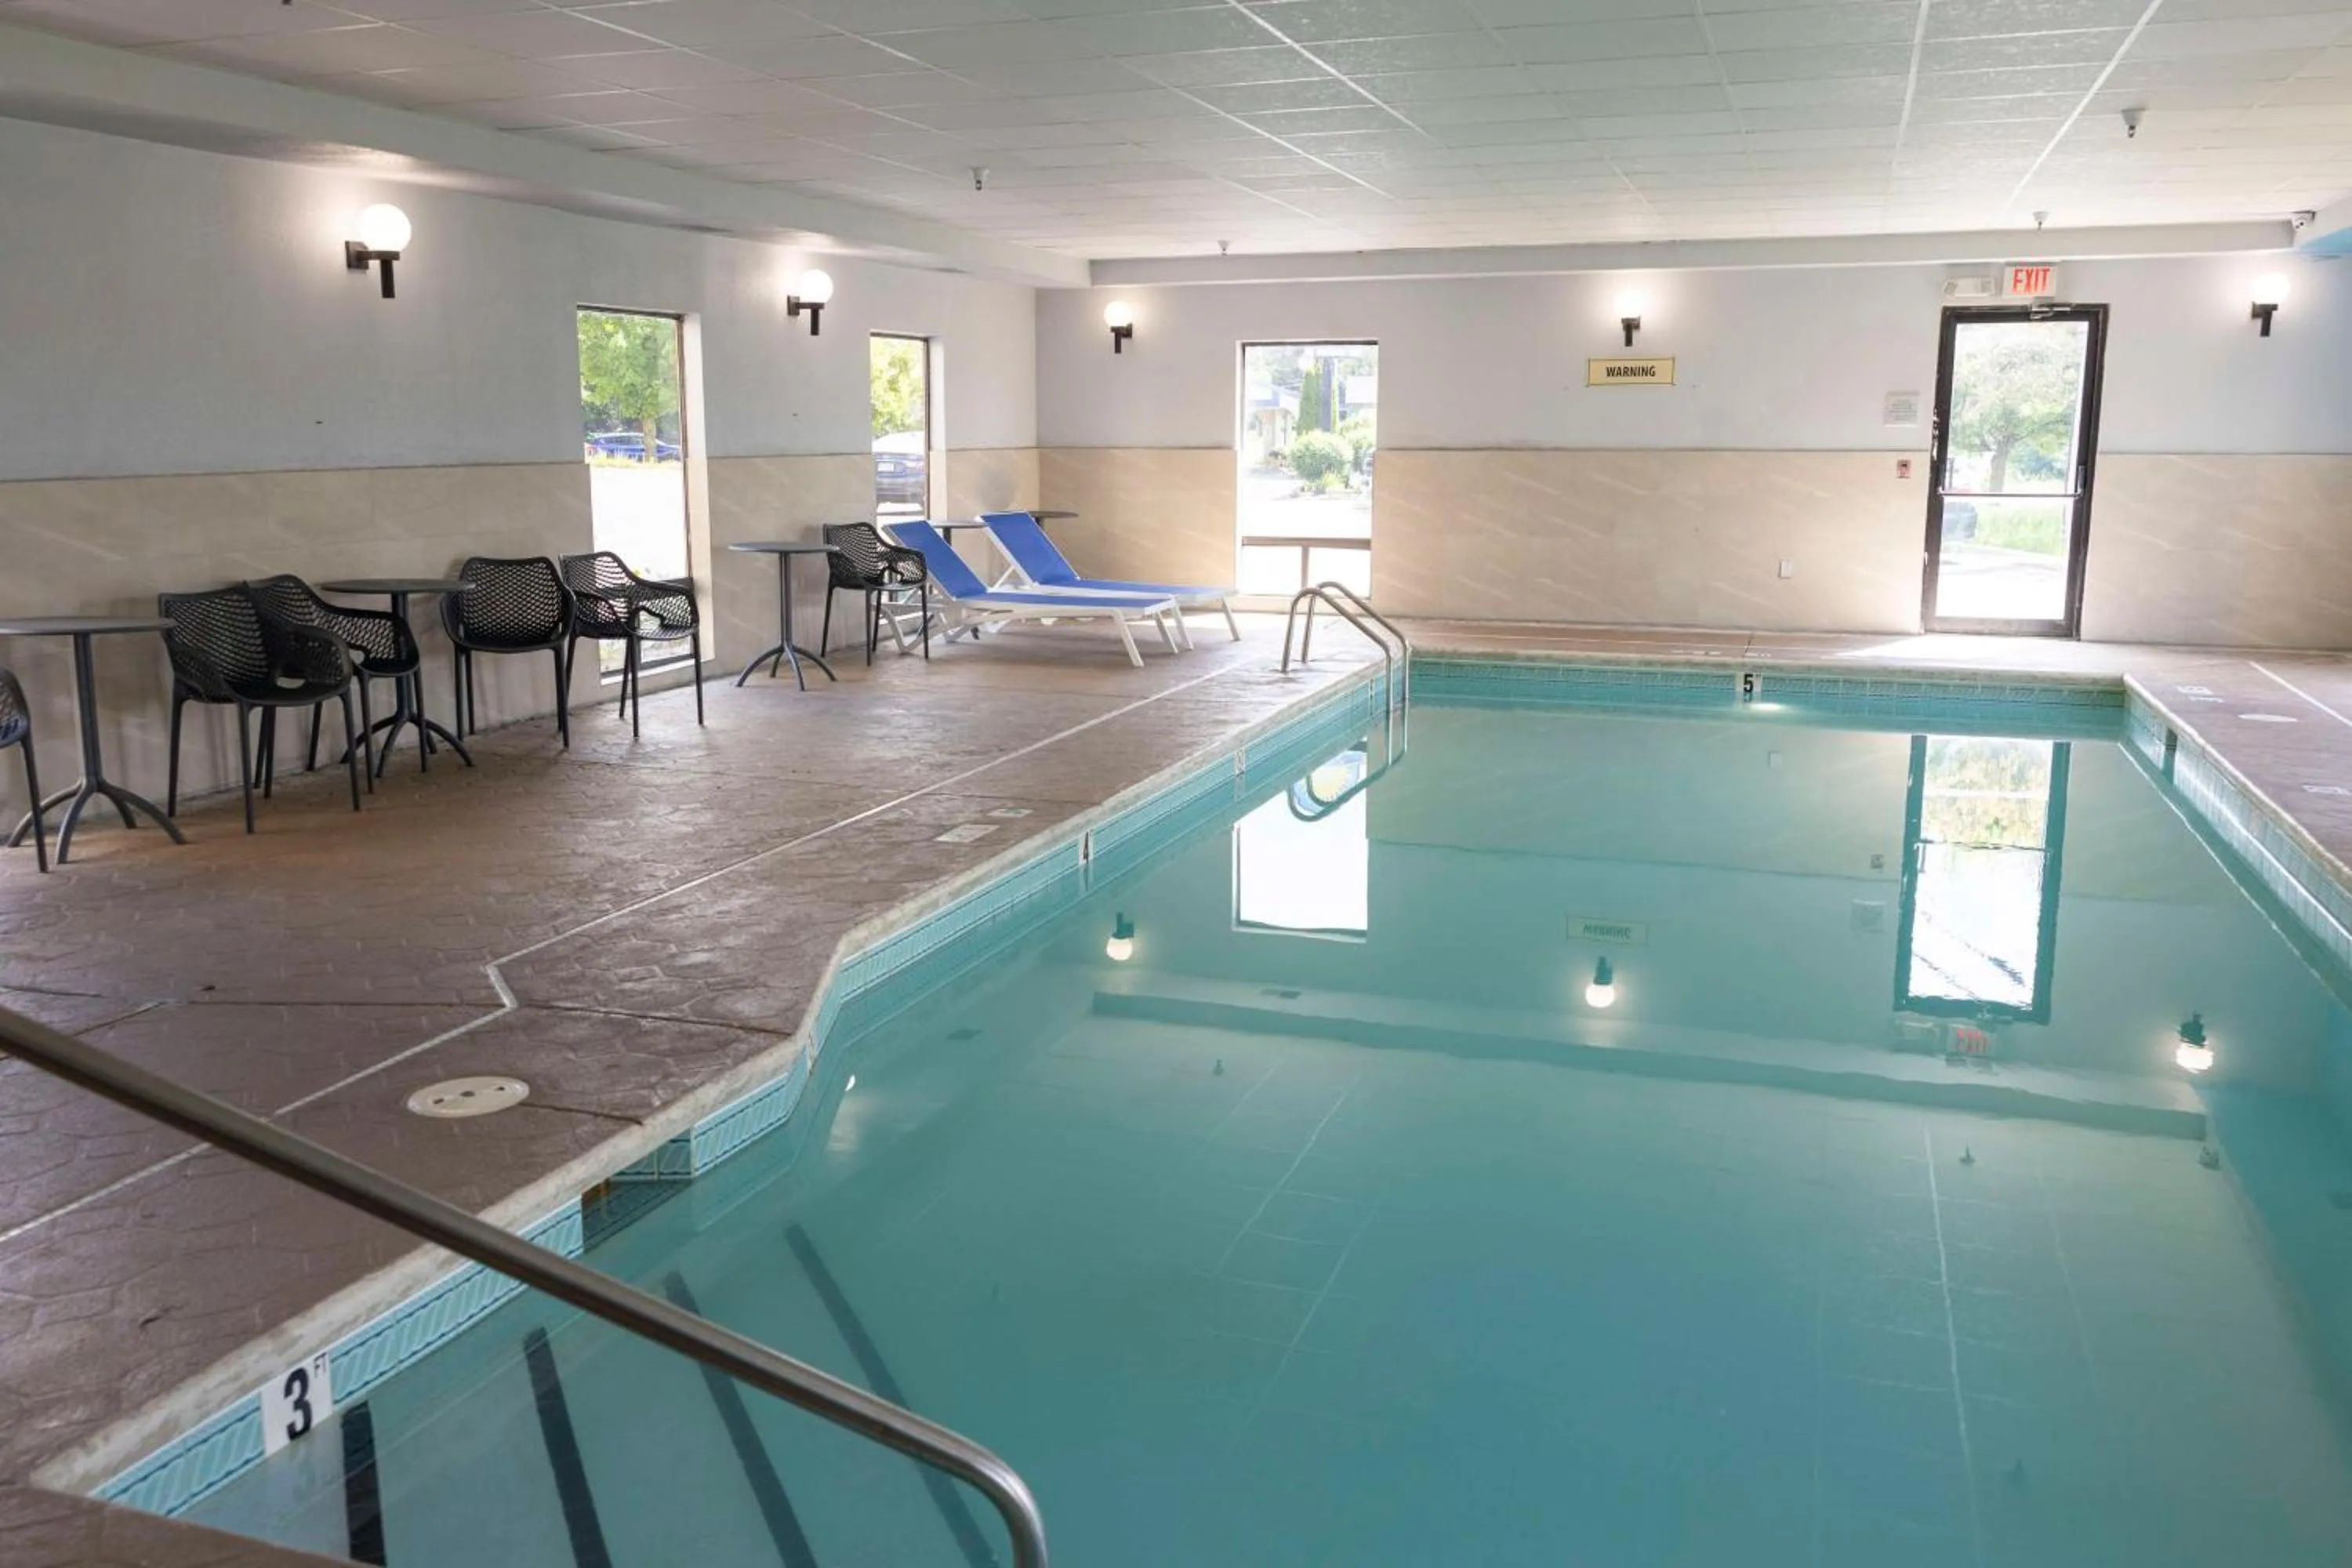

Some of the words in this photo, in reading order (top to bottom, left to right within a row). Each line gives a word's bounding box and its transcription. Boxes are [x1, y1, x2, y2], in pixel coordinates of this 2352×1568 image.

[2012, 267, 2051, 294] EXIT
[1606, 365, 1656, 377] WARNING
[1743, 673, 1754, 692] 5
[284, 1367, 312, 1441] 3
[314, 1352, 327, 1378] FT
